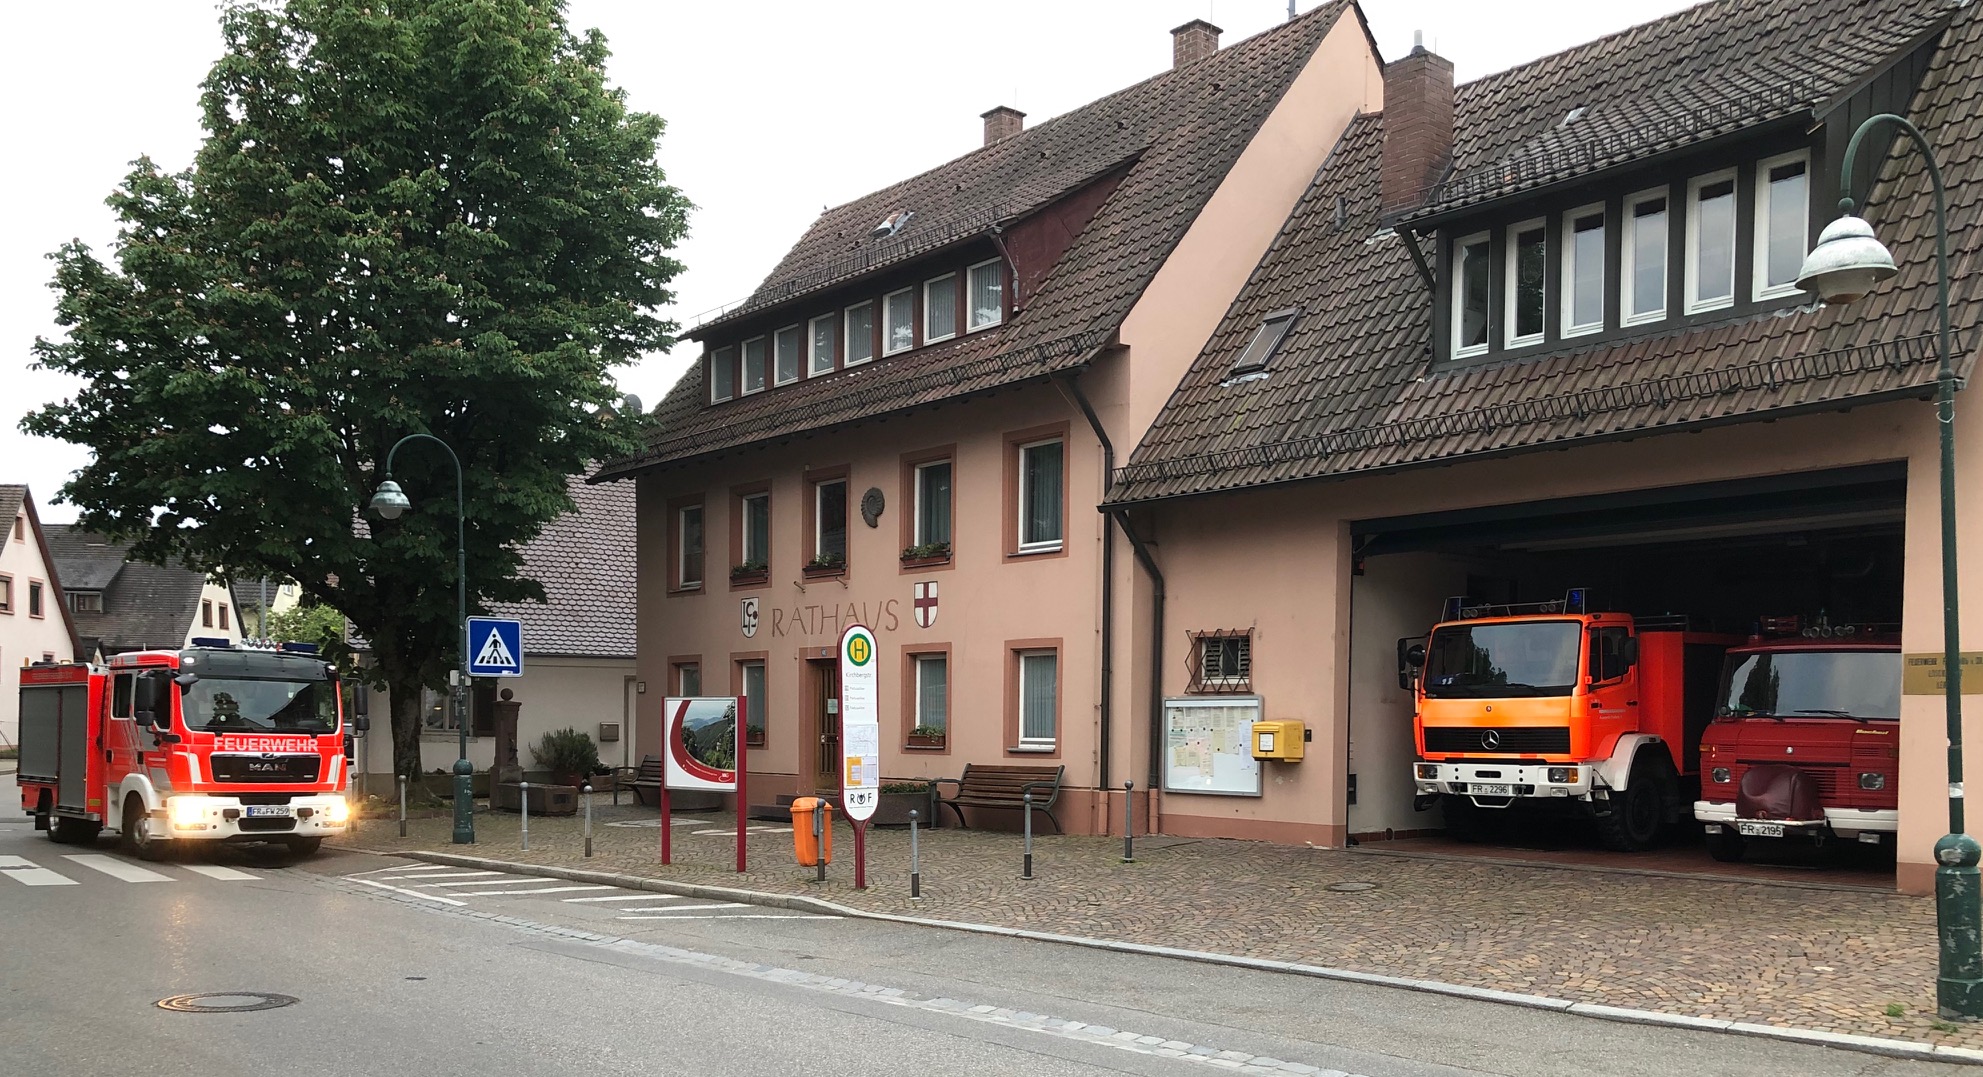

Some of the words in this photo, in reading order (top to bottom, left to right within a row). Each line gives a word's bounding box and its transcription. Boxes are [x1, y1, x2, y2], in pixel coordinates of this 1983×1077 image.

[772, 599, 899, 637] RATHAUS
[854, 641, 864, 659] H
[213, 737, 318, 752] FEUERWEHR
[249, 763, 287, 771] MAN
[1472, 785, 1483, 793] FR
[1490, 785, 1508, 794] 2296
[1741, 824, 1755, 834] FR
[1761, 825, 1782, 836] 2195
